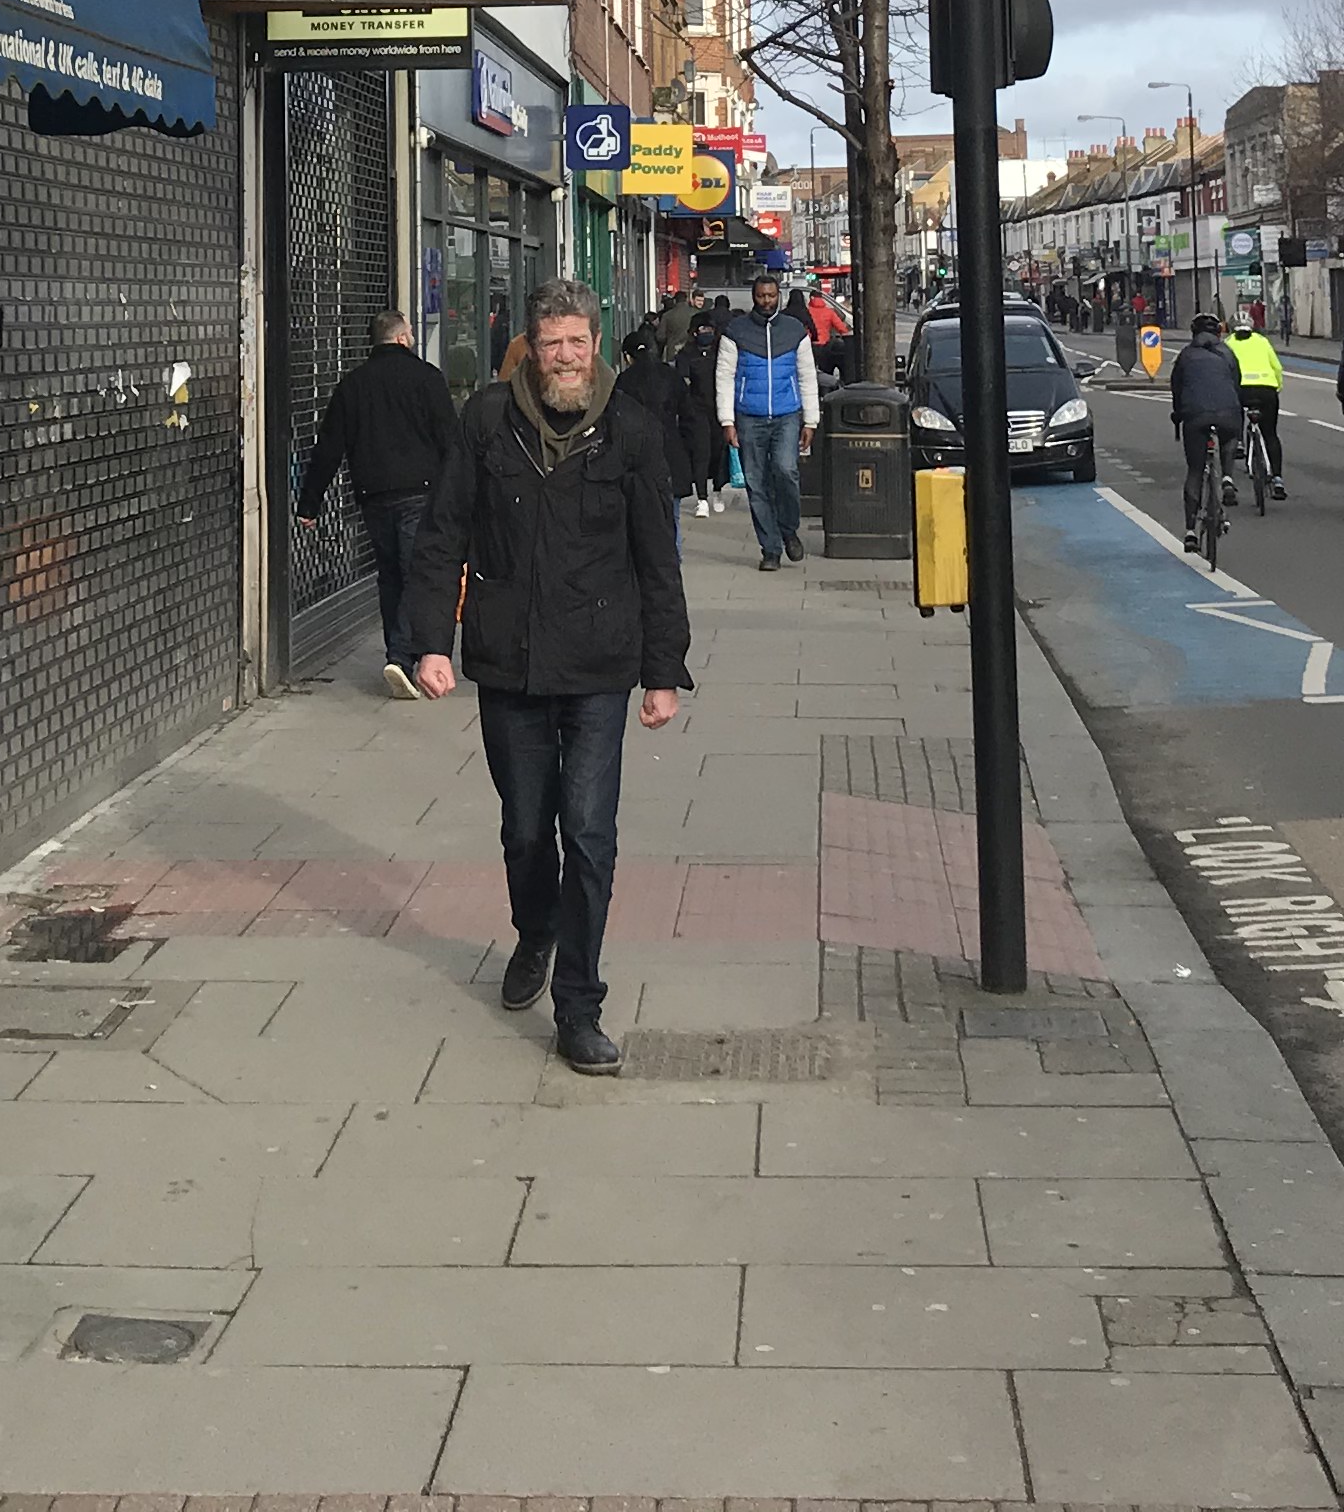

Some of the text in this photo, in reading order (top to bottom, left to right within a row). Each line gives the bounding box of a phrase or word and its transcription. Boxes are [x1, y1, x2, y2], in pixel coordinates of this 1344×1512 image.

[310, 19, 425, 31] MONEY TRANSFER
[274, 44, 462, 58] send & receive money worldwide from here
[47, 39, 57, 73] &
[58, 43, 75, 77] UK
[122, 62, 131, 92] &
[131, 65, 144, 95] 4G
[144, 68, 164, 101] data
[631, 144, 683, 159] Paddy
[630, 162, 684, 175] Power
[1173, 825, 1313, 886] LOOK
